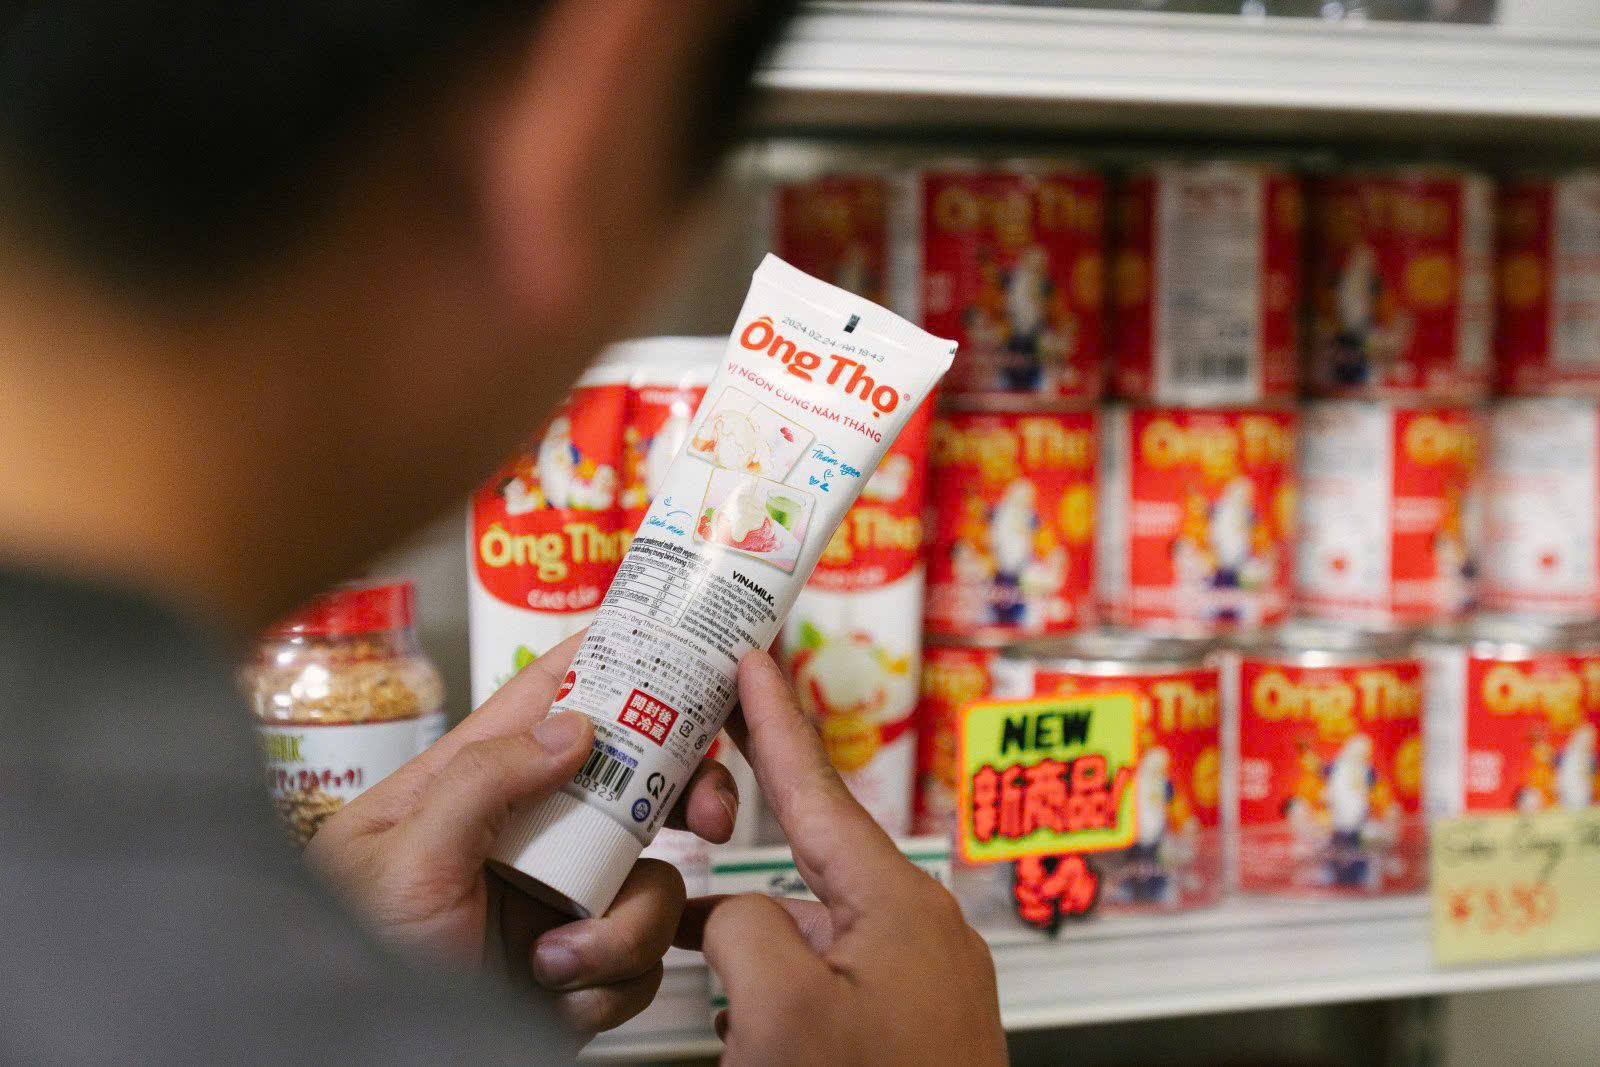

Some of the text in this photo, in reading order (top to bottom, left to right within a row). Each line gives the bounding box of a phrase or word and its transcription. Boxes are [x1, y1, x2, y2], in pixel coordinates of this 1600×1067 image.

[741, 317, 898, 418] Ông Thọ
[737, 366, 774, 393] NGON
[841, 415, 883, 443] THÁNG
[480, 521, 568, 582] Ông
[732, 570, 775, 605] VINAMILK
[653, 624, 689, 645] Condensed
[687, 640, 708, 656] Cream
[621, 706, 666, 740] 要冷蔵
[629, 692, 674, 726] 開封後
[1001, 711, 1092, 754] NEW
